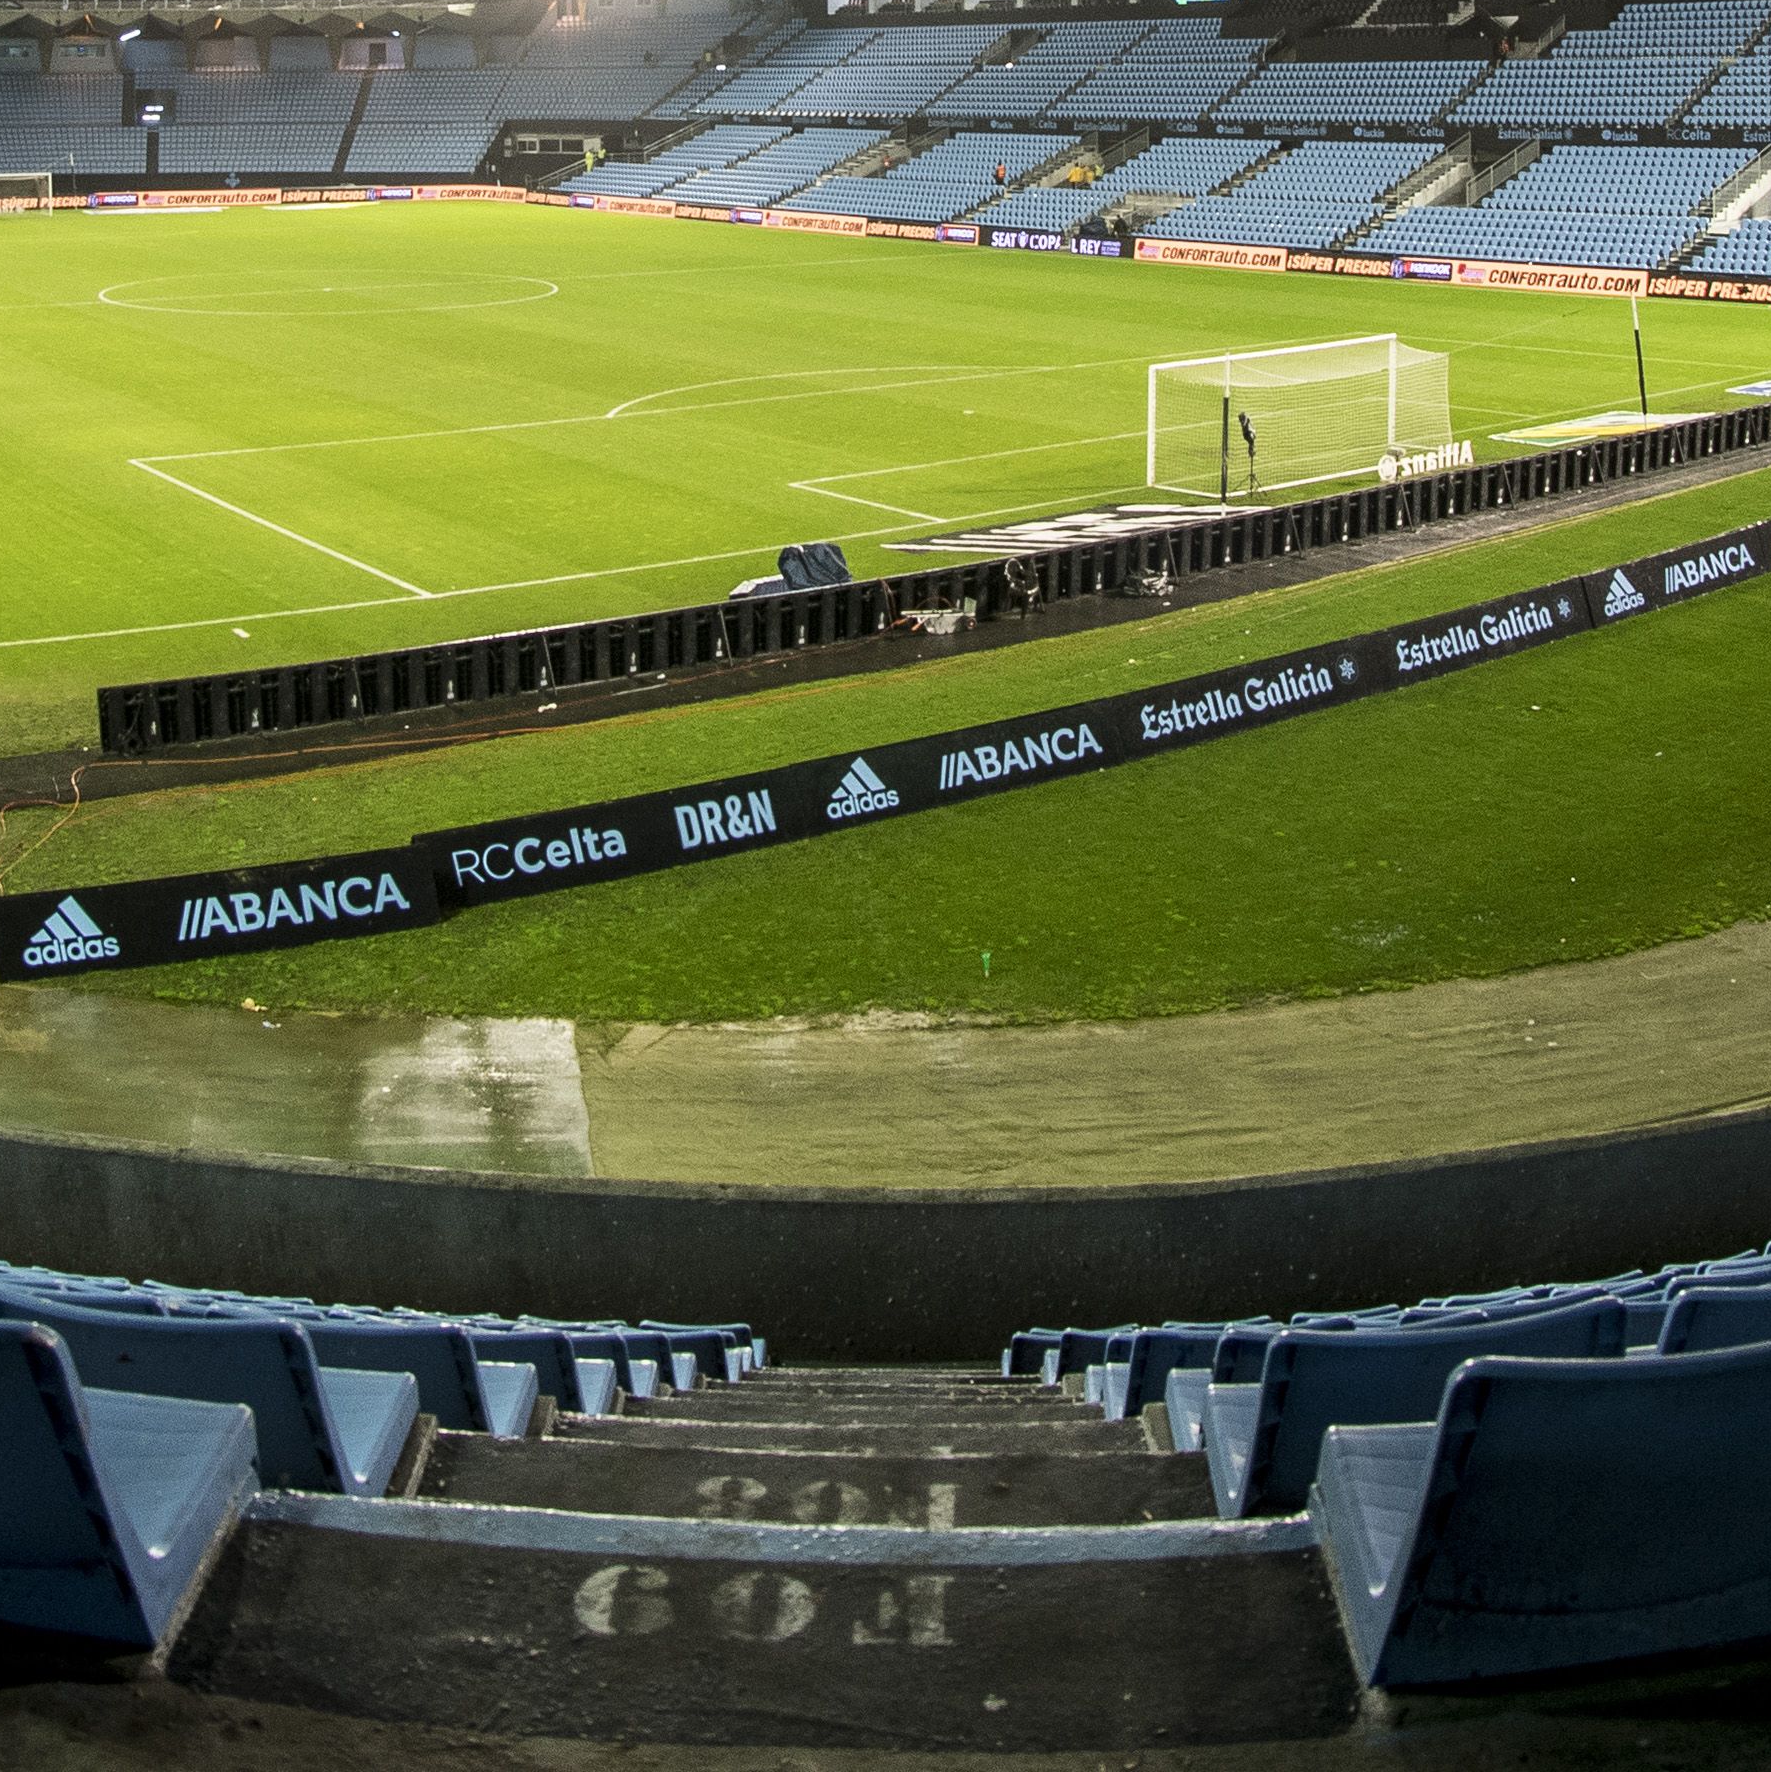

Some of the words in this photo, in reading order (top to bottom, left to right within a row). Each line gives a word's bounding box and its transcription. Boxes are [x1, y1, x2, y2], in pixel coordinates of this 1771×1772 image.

[991, 230, 1016, 248] SEAT
[1079, 238, 1101, 255] REY
[1604, 591, 1645, 617] adidas
[1395, 626, 1480, 672] Estrella
[1479, 601, 1553, 650] Galicia
[1140, 688, 1243, 740] Estrella
[1244, 662, 1333, 713] Galicia
[675, 788, 778, 850] DR&N
[827, 788, 900, 819] adidas
[23, 934, 120, 968] adidas
